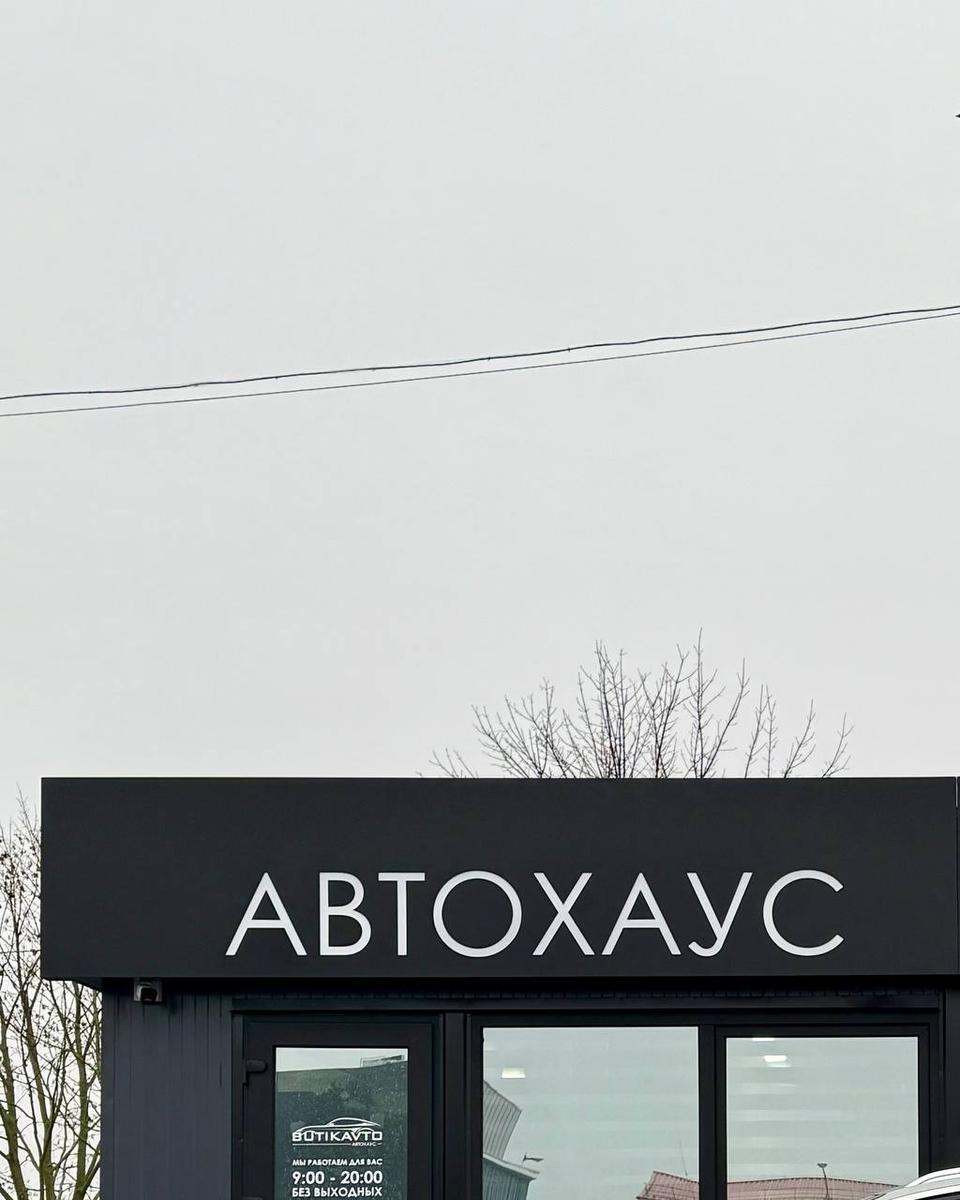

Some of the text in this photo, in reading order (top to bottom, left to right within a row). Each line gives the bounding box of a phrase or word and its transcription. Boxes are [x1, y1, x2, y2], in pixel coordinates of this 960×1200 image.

[226, 870, 845, 958] АВТОХАУС
[292, 1131, 383, 1142] BUTIKAVTO
[292, 1170, 325, 1185] 9:00
[340, 1170, 383, 1184] 20:00
[291, 1187, 383, 1198] БЕЗ ВЫХОДНЫХ
